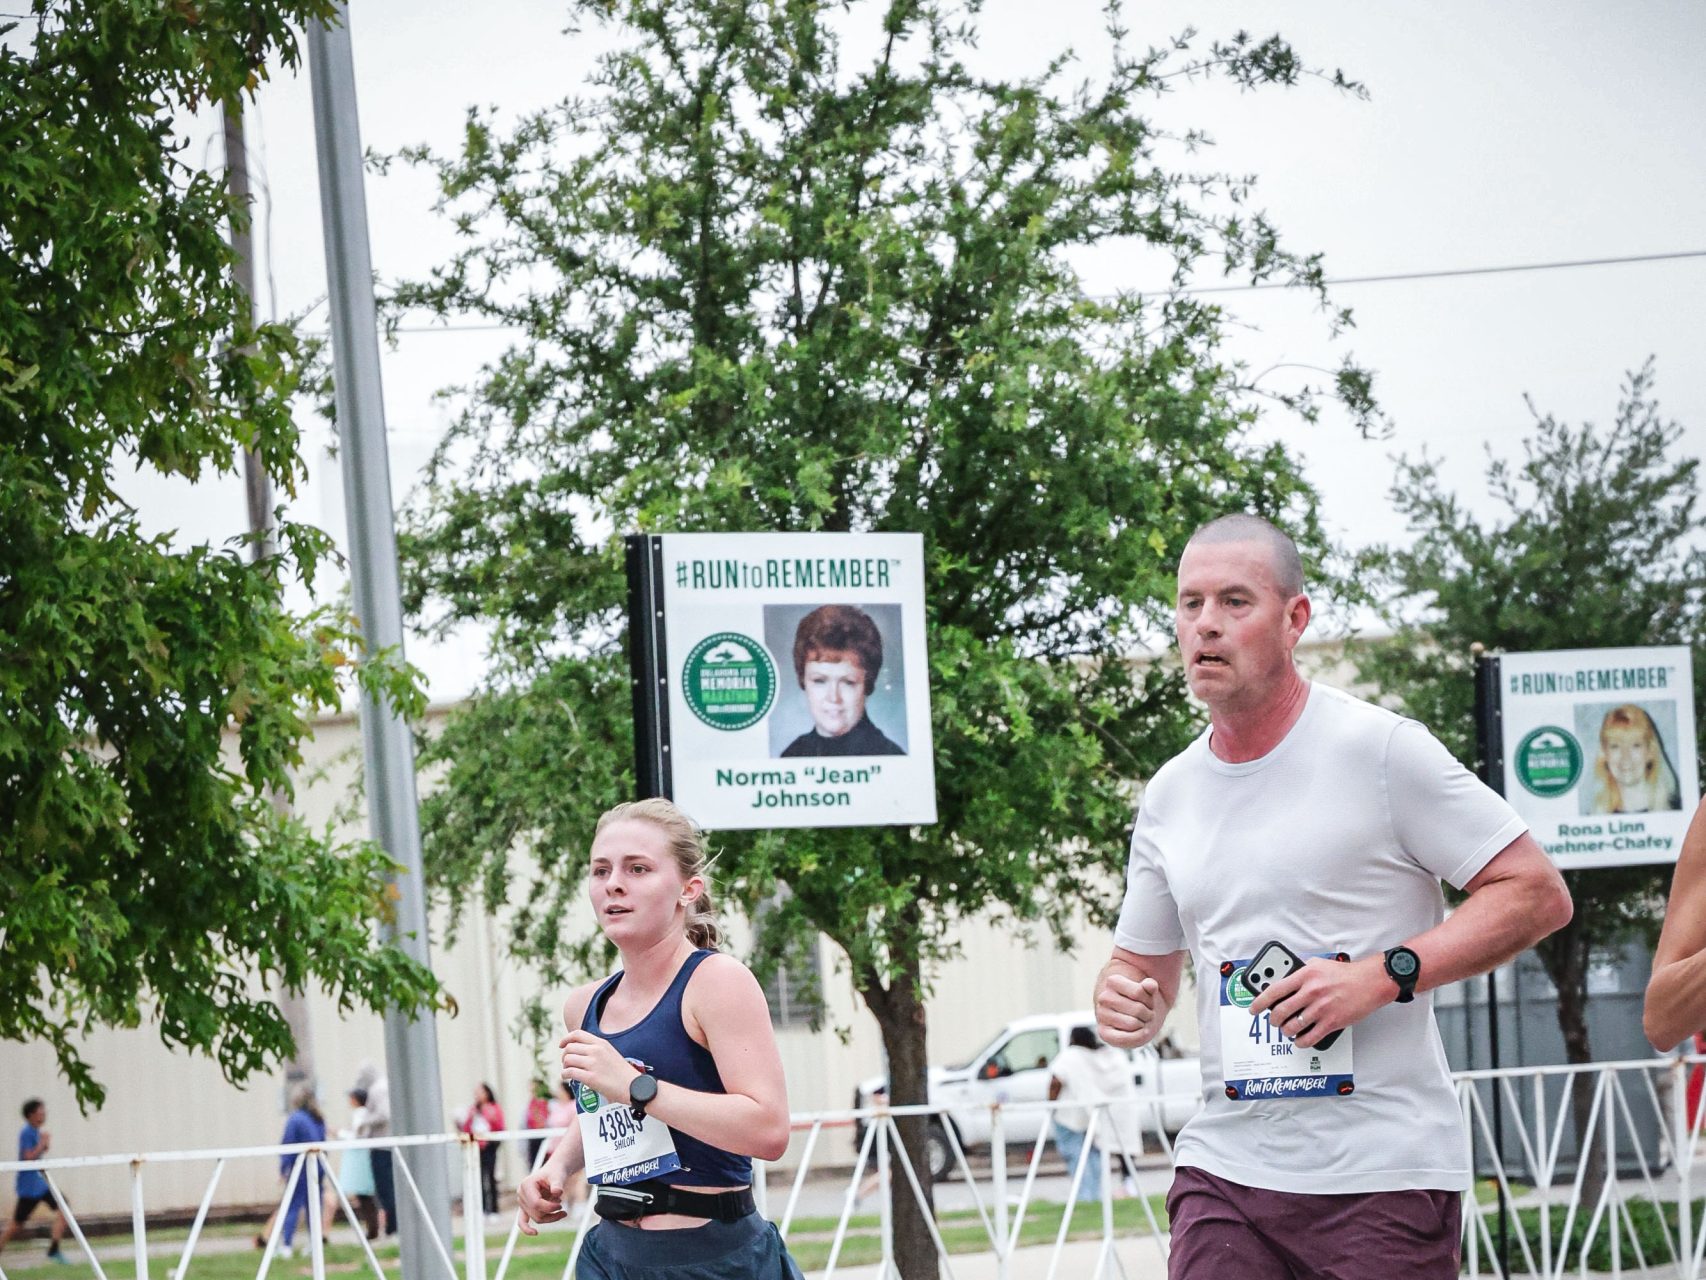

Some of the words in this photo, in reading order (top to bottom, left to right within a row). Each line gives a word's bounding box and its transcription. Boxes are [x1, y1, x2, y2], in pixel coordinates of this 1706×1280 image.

[716, 768, 796, 787] Norma
[804, 766, 882, 785] “Jean”
[751, 790, 850, 808] Johnson
[1558, 823, 1603, 836] Rona
[1608, 820, 1645, 834] Linn
[1541, 835, 1673, 854] uehner-Chafey
[1271, 1043, 1293, 1056] ERIK
[614, 1135, 635, 1151] SHILOH
